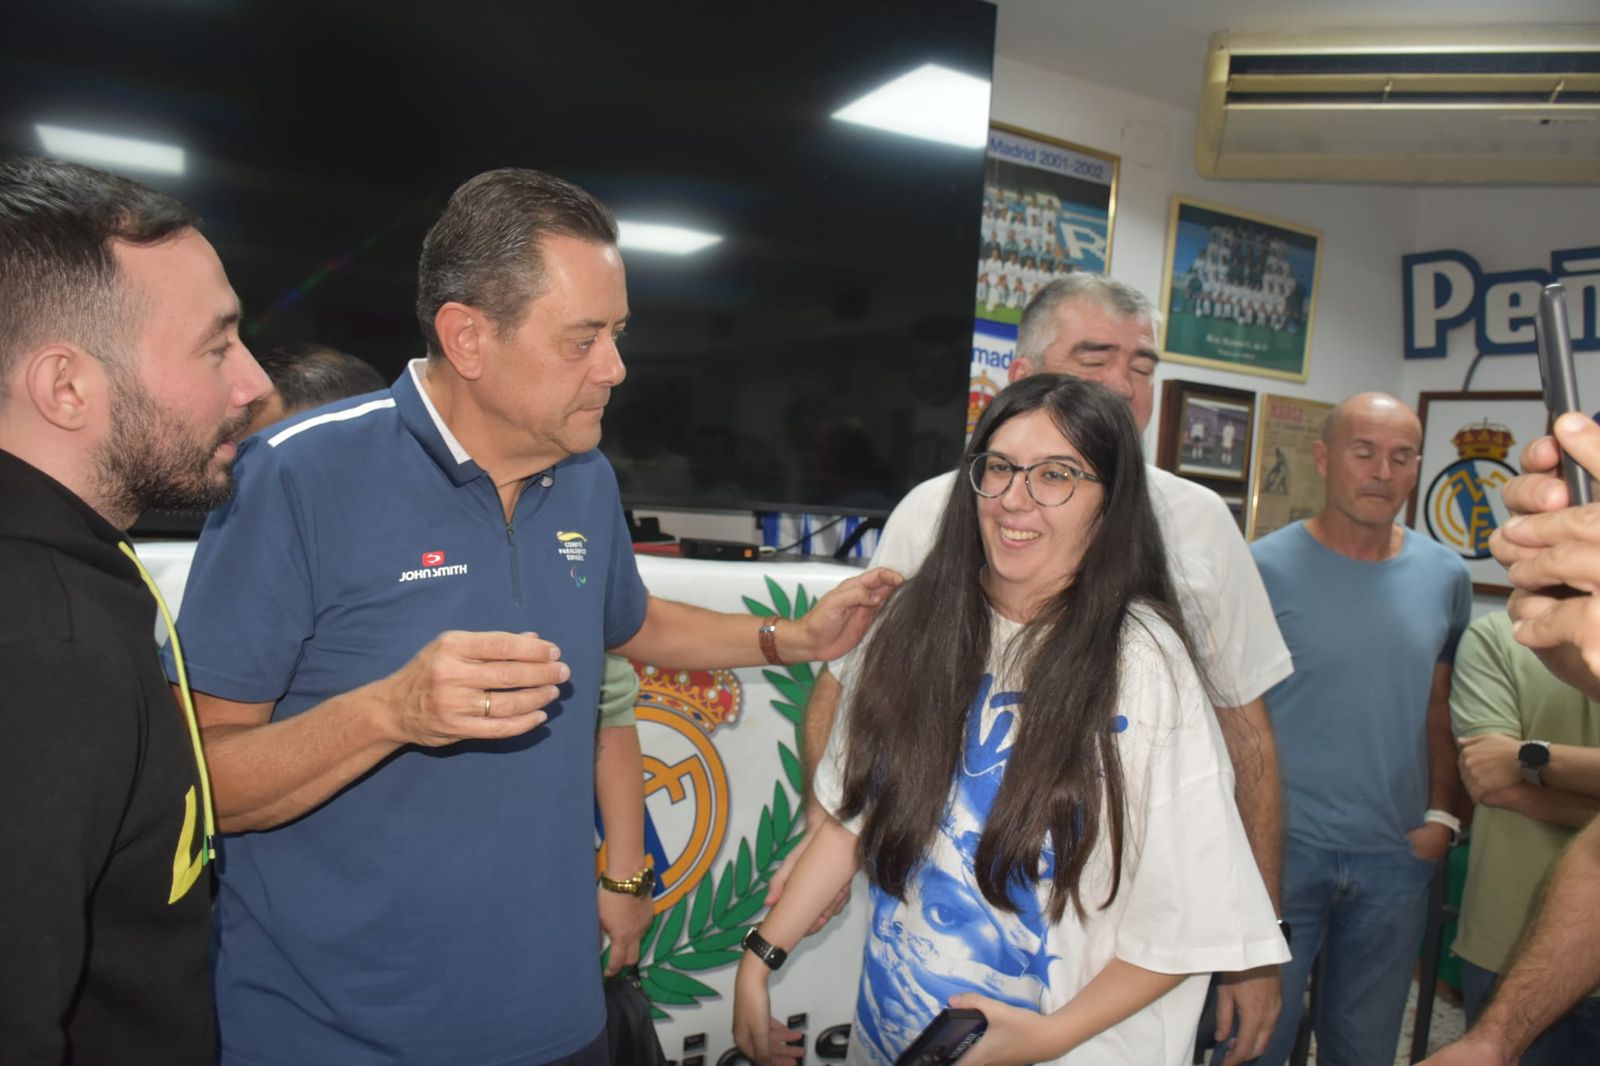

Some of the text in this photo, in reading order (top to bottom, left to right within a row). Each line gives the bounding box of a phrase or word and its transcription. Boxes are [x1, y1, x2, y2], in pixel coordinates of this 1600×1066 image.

[990, 136, 1103, 178] Madrid 2001-2002
[399, 564, 468, 582] JOHN SMITH
